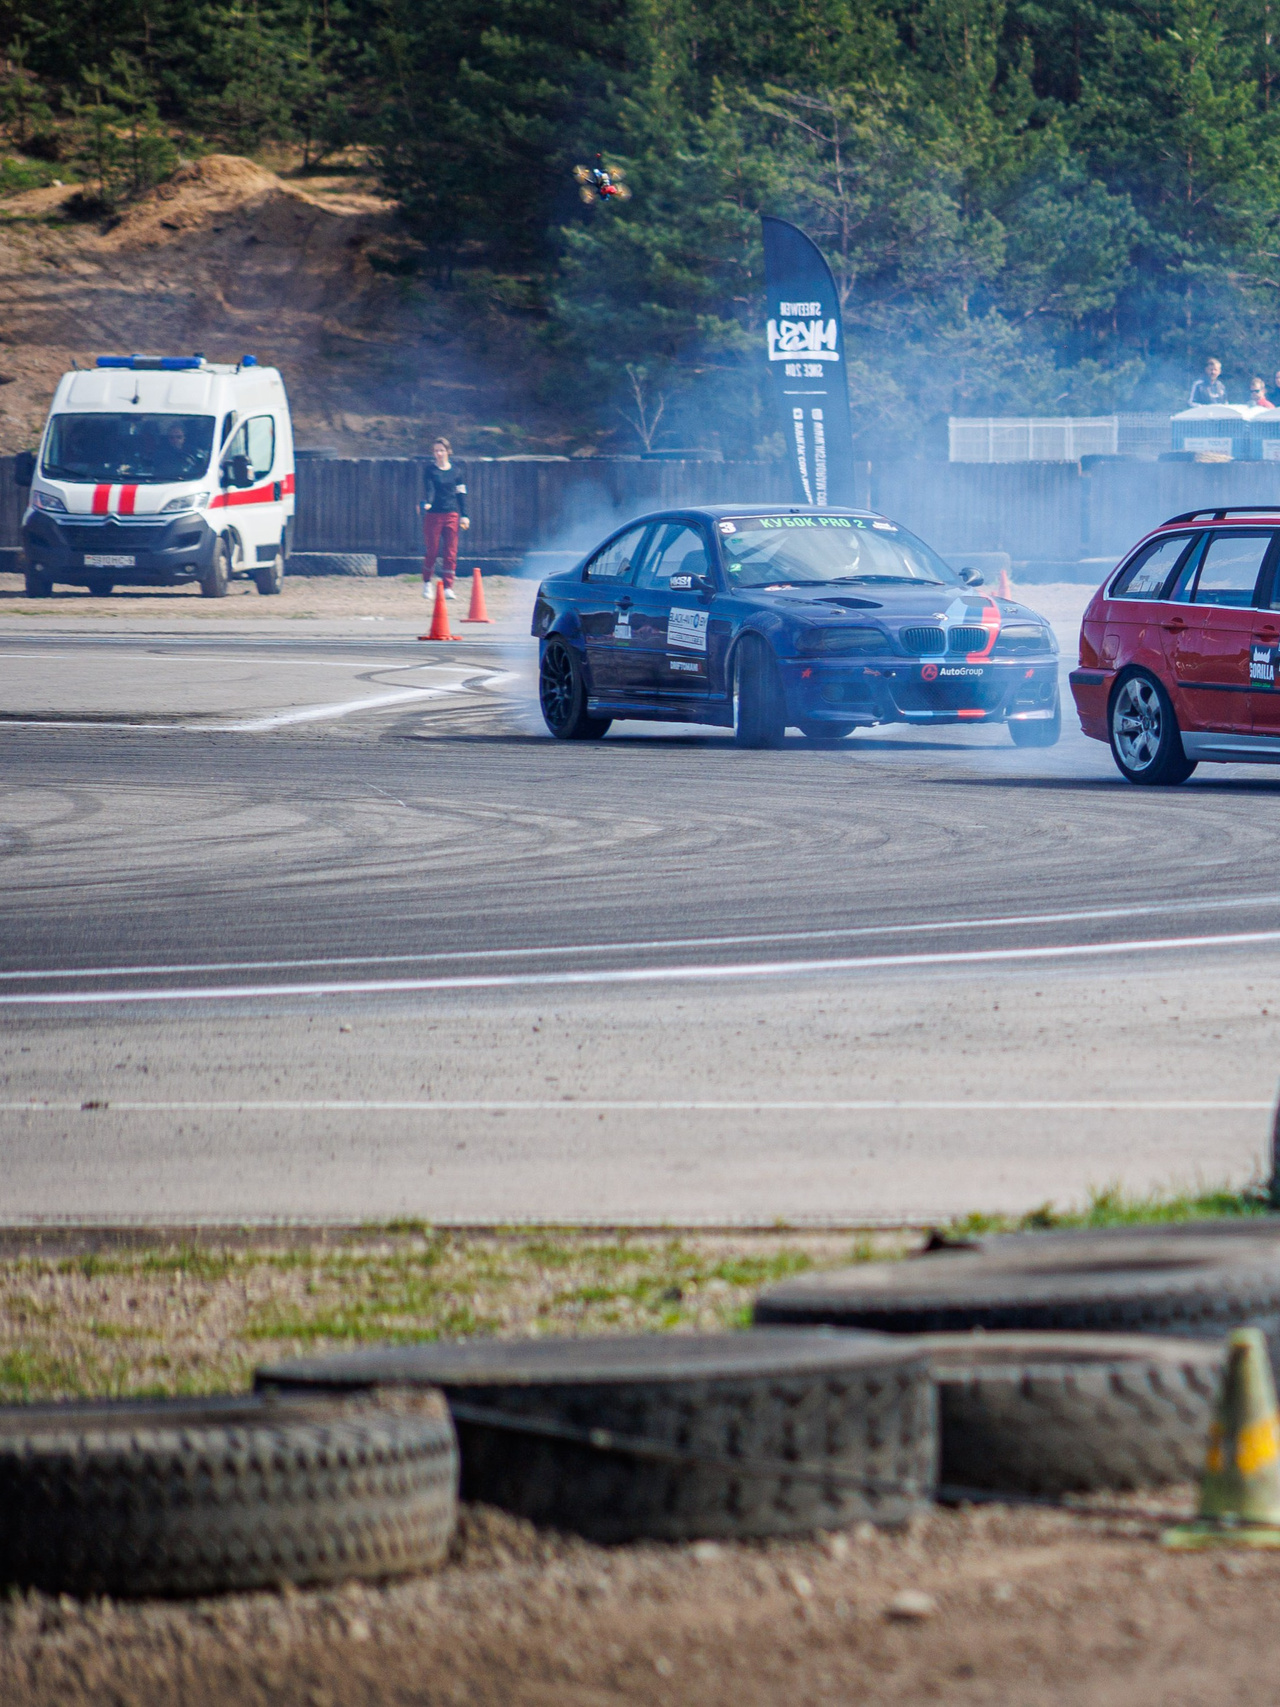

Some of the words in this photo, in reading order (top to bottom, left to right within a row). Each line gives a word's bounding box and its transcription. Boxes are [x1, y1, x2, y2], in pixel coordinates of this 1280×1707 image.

[718, 521, 737, 534] 3
[759, 517, 816, 529] КУБОК
[817, 517, 852, 527] PRO
[853, 519, 867, 529] 2
[940, 667, 984, 677] AutoGroup
[1249, 662, 1274, 680] GORILLA
